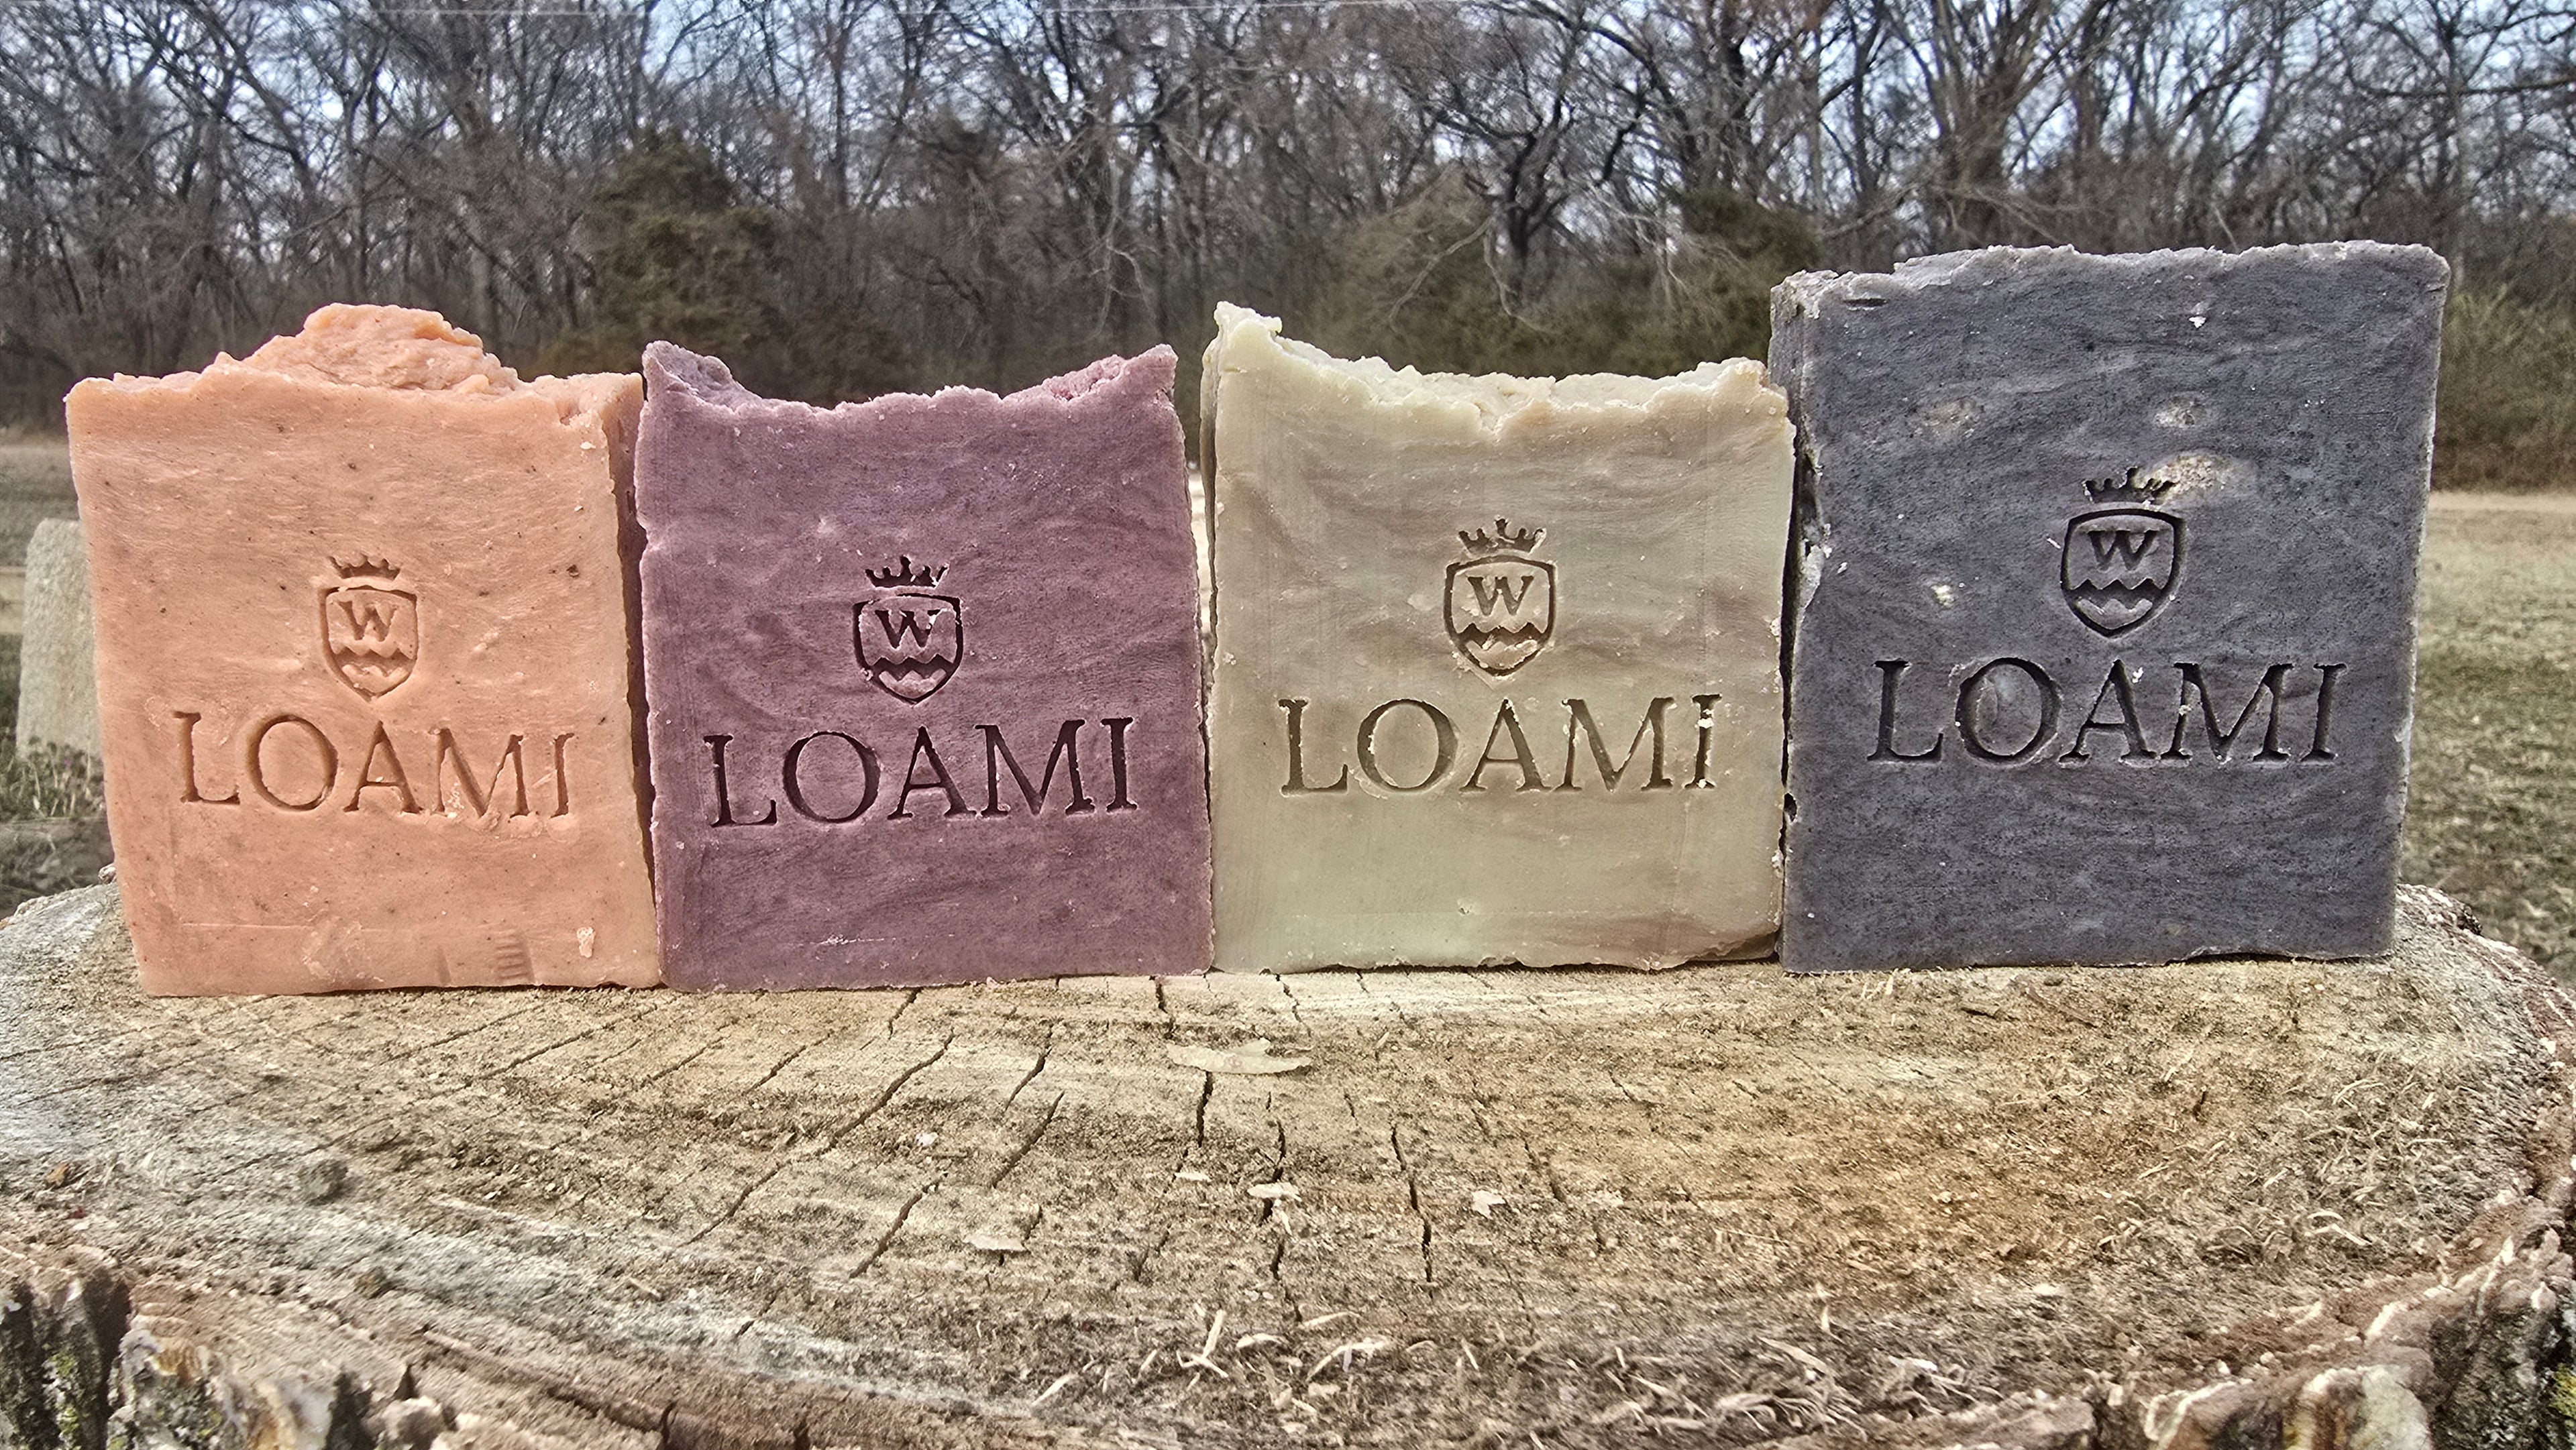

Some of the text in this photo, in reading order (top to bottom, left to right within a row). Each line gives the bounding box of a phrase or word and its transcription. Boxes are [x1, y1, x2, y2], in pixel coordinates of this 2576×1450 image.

[2088, 529, 2159, 571] W
[337, 600, 397, 642] W
[874, 609, 942, 649] W
[1466, 575, 1535, 616] W
[1278, 693, 1723, 792] LOAMI
[1868, 657, 2347, 762] LOAMI
[171, 711, 575, 818] LOAMI
[702, 716, 1138, 828] LOAMI
